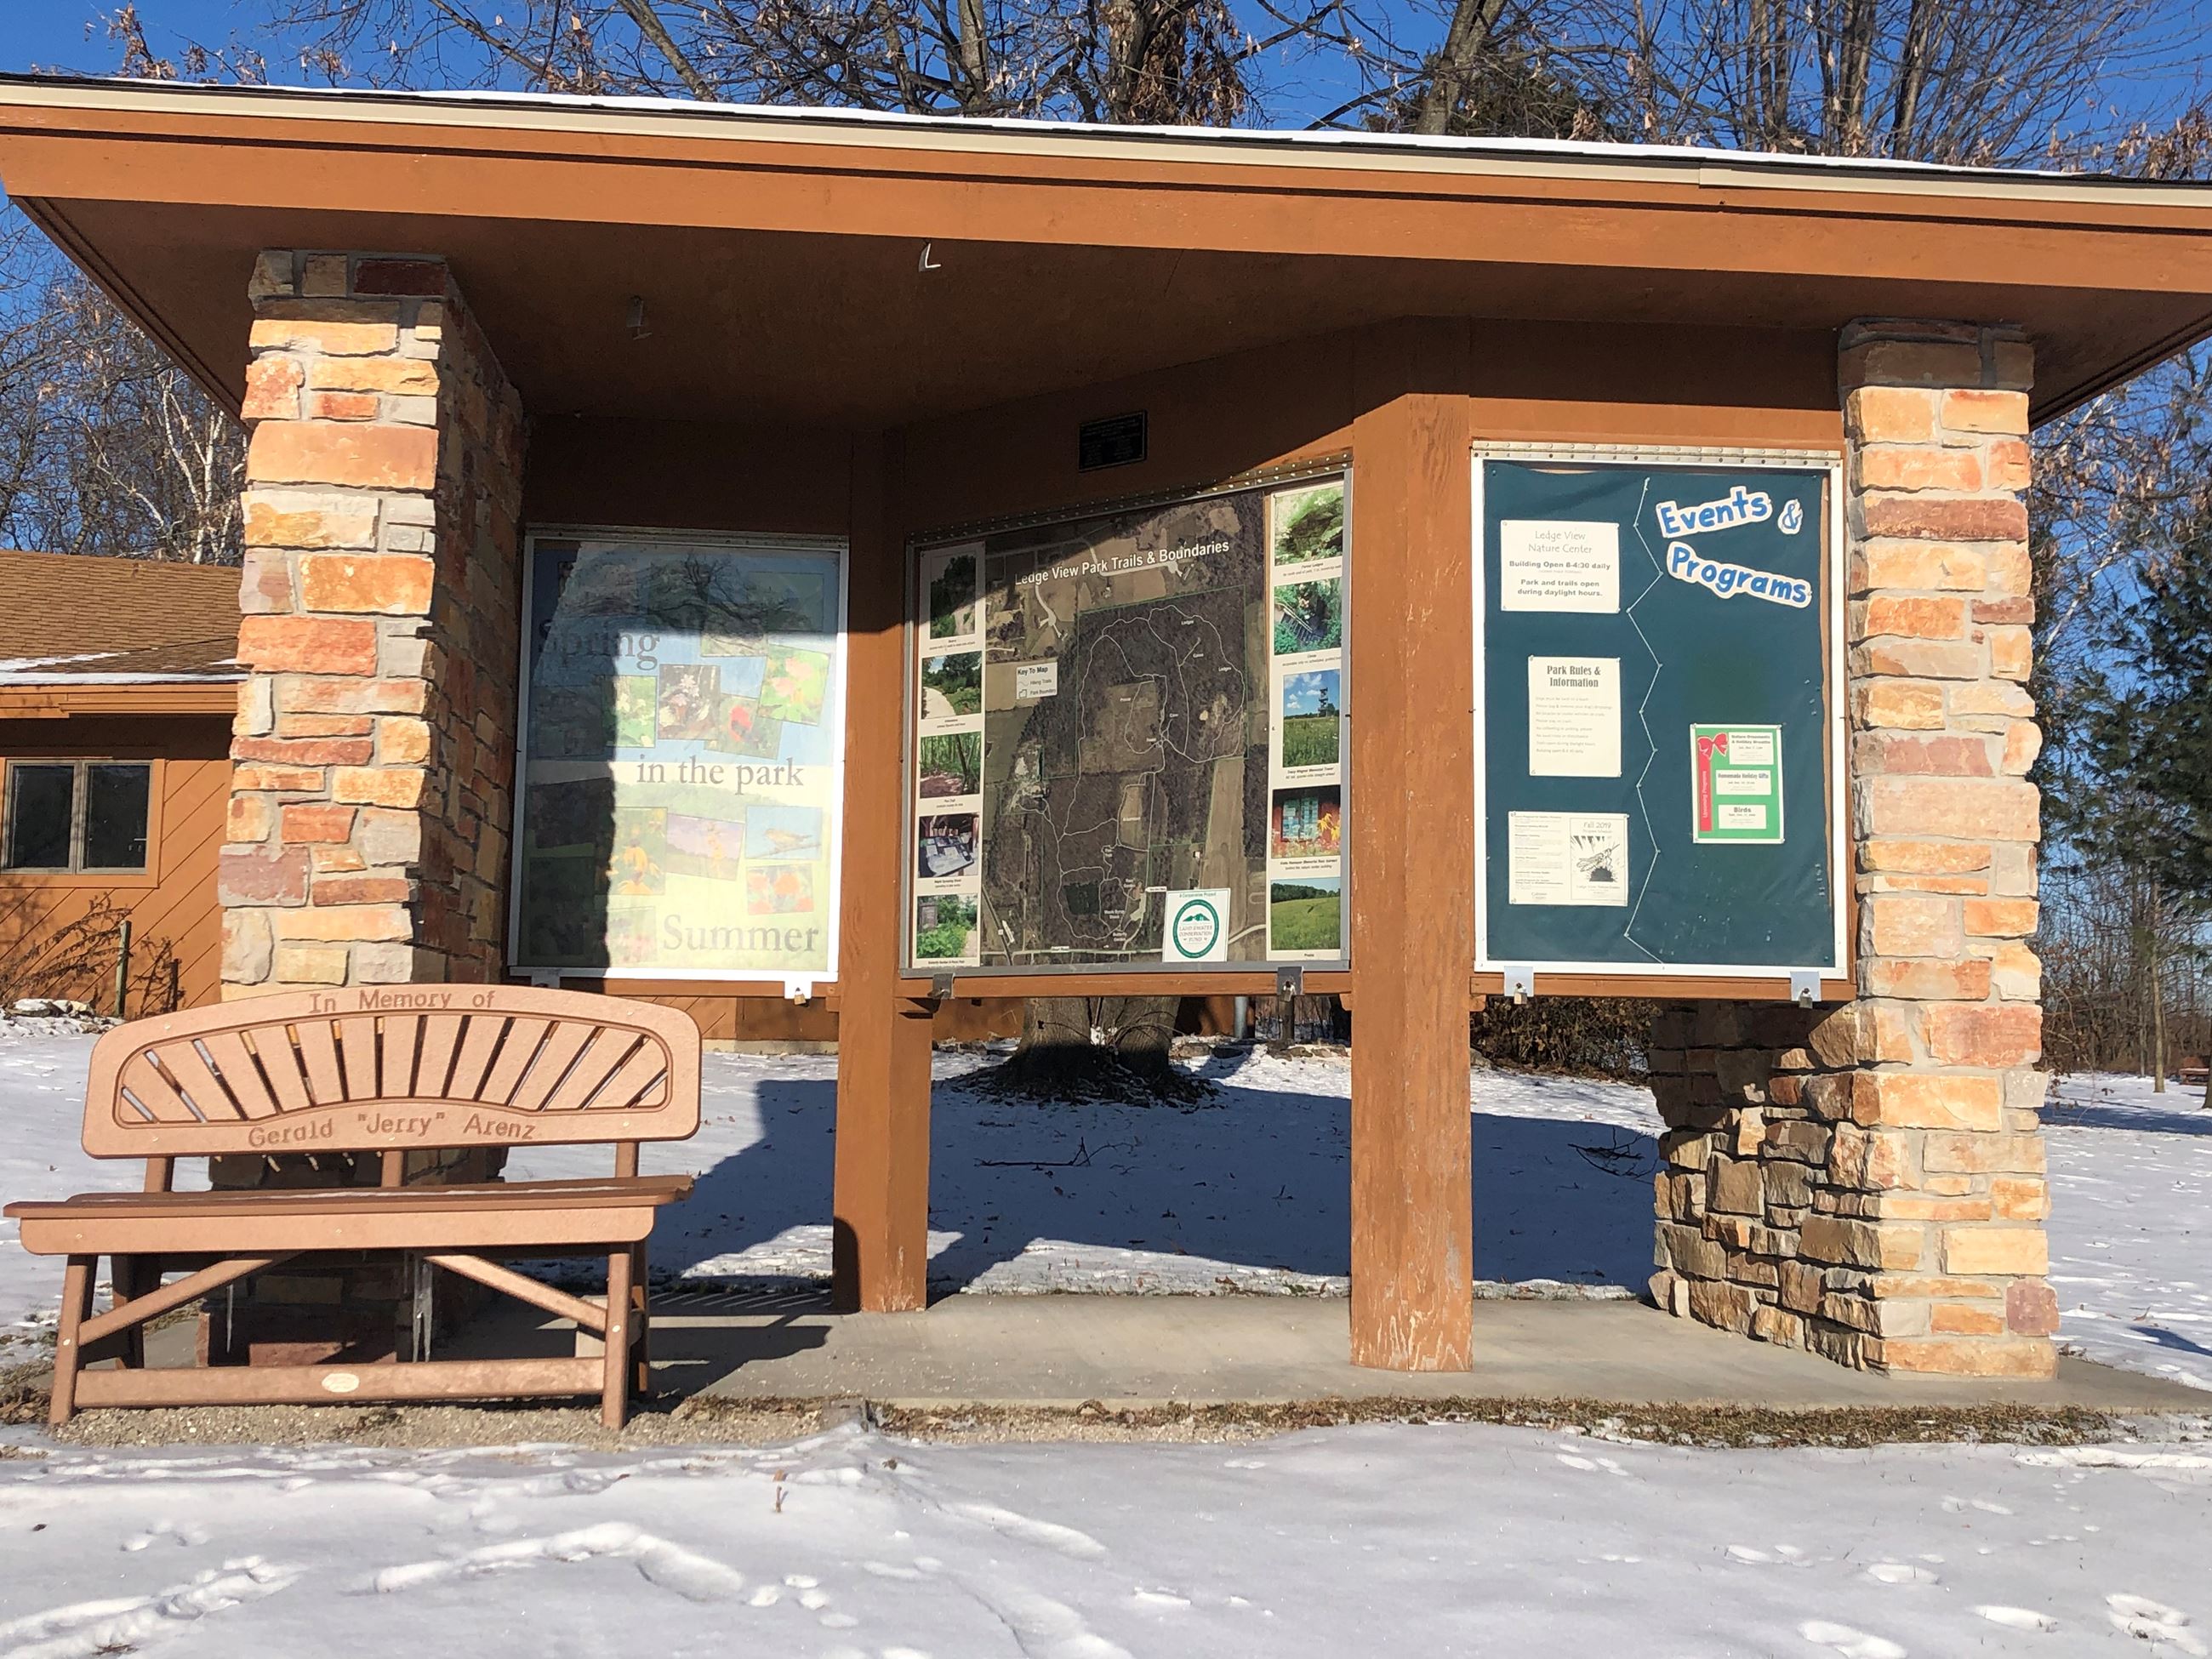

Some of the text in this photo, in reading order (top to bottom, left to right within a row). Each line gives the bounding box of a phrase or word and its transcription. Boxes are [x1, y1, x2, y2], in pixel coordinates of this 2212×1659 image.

[1660, 490, 1803, 534] Events &
[1528, 544, 1593, 554] Nature Center
[1535, 530, 1587, 543] Ledge View
[1015, 541, 1230, 585] Ledge View Park Trails & Boundaries
[1509, 561, 1542, 569] Building
[1543, 561, 1564, 569] Open
[1591, 562, 1611, 571] daily
[1671, 546, 1807, 603] Programs
[1544, 589, 1576, 597] daylight
[1547, 665, 1601, 676] Park Rules &
[1549, 677, 1599, 687] Information
[636, 754, 805, 796] in the park
[663, 914, 819, 953] Summer
[309, 989, 496, 1014] In Memory of
[247, 1111, 538, 1149] Gerald "Jerry" Arenz
